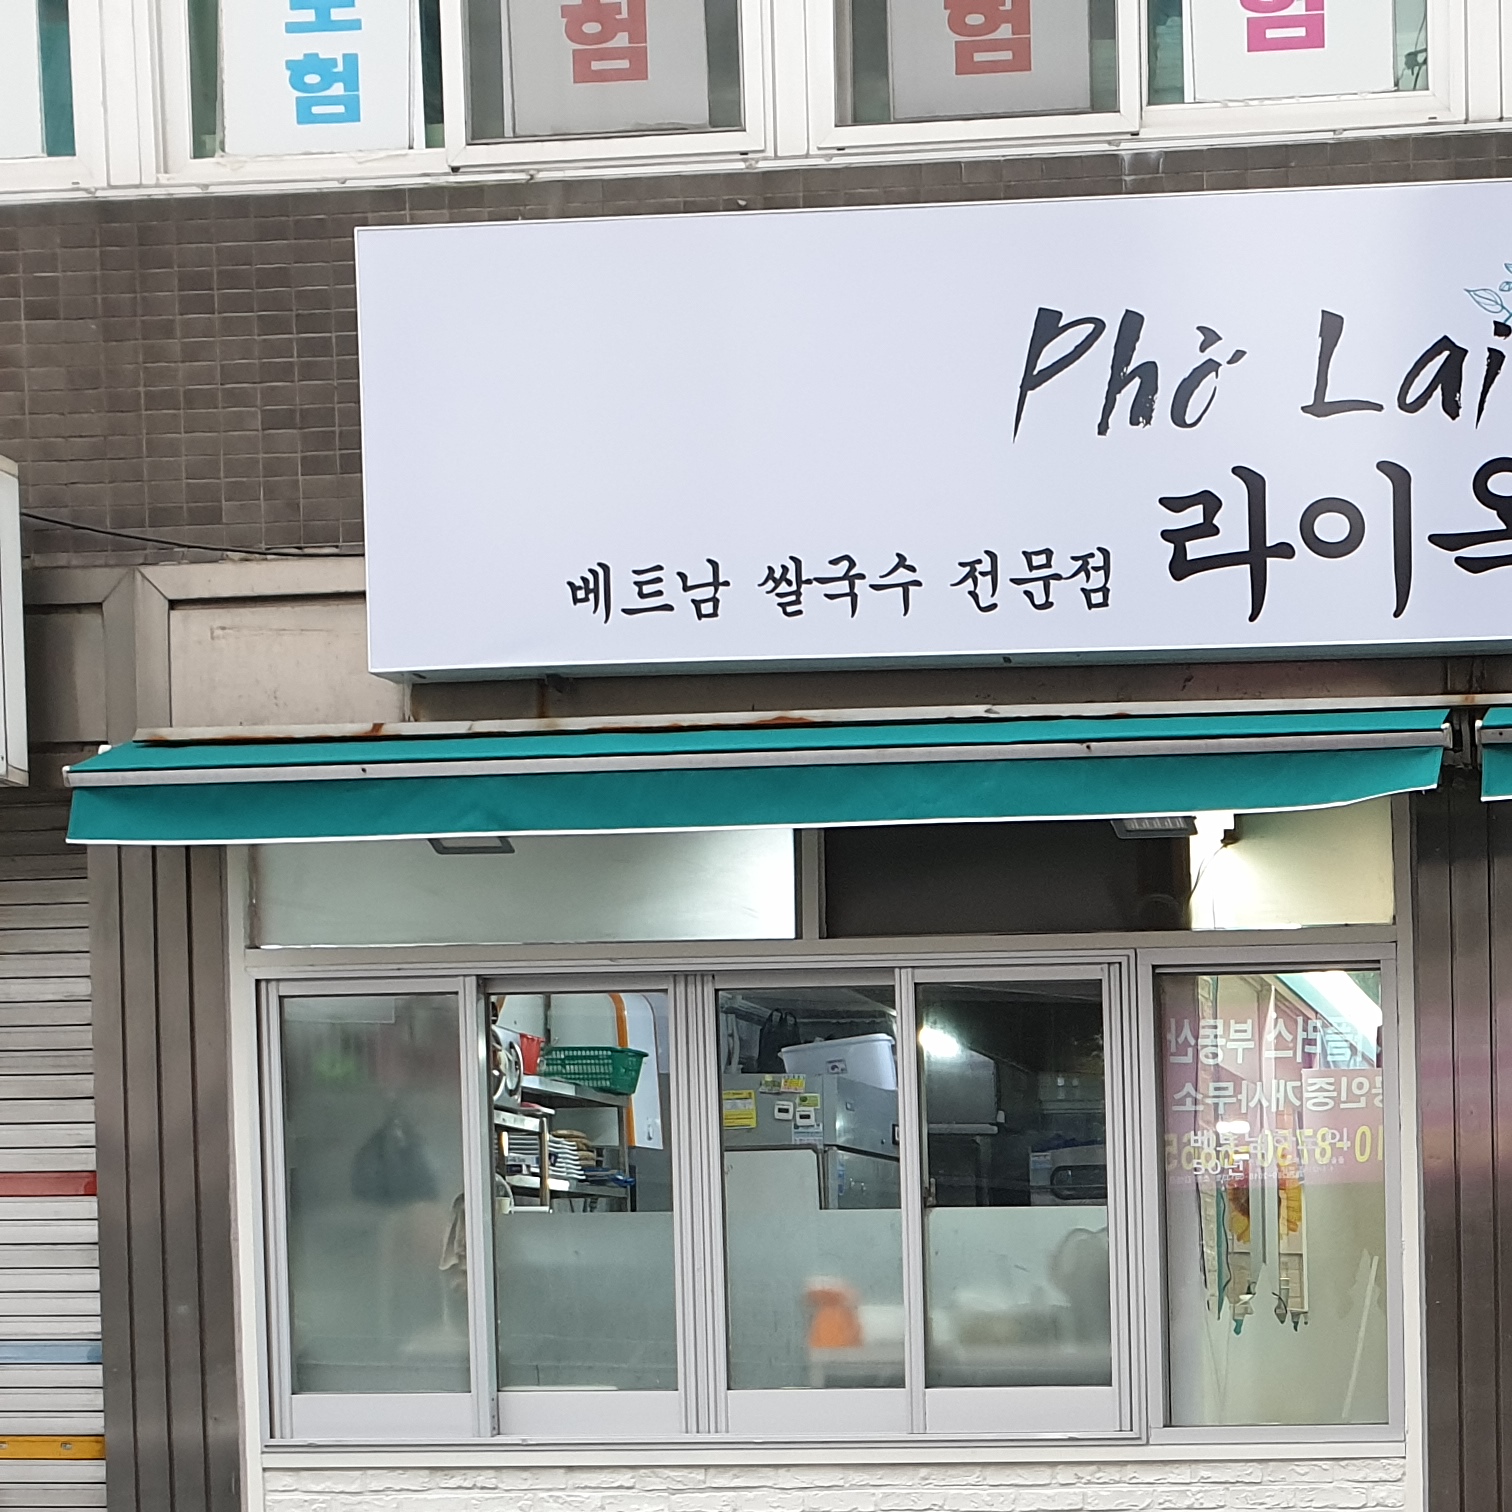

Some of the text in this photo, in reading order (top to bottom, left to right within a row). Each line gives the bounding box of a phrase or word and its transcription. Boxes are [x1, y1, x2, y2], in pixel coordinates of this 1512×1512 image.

[1300, 308, 1512, 430] Lai
[565, 546, 1112, 625] 베트남 쌀국수 전문점
